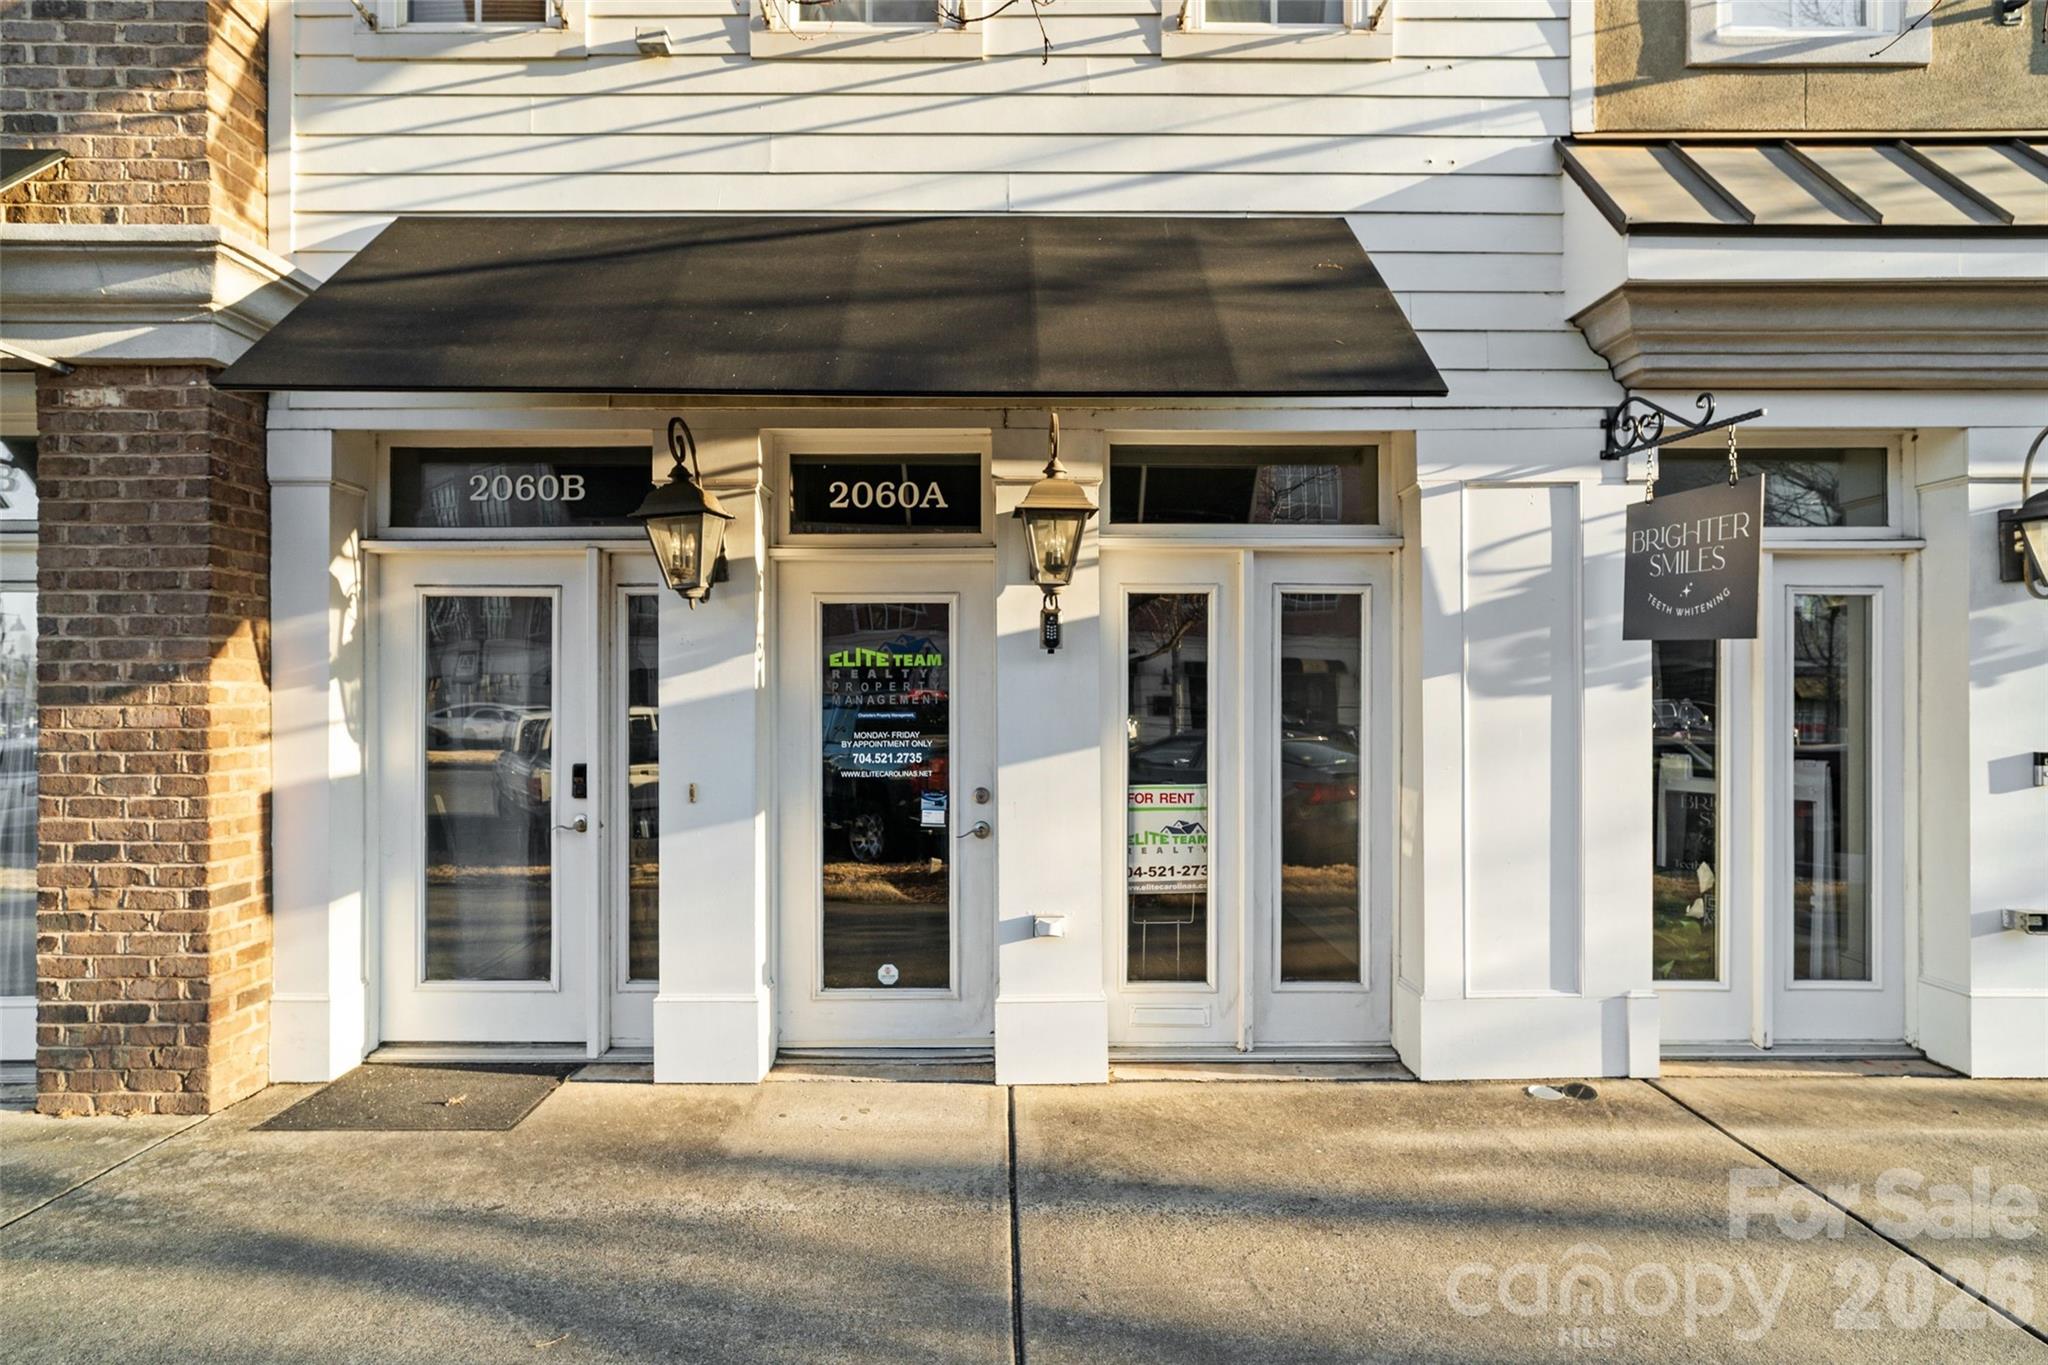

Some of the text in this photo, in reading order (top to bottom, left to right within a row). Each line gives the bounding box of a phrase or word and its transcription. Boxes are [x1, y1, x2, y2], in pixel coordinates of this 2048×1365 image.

[469, 475, 586, 502] 2060B
[828, 482, 948, 509] 2060A
[1632, 512, 1750, 554] BRIGHTER
[1649, 545, 1726, 577] SMILES
[1647, 587, 1731, 616] TEETH WHITENING
[829, 647, 942, 667] ELITE TEAM
[832, 669, 927, 679] REALTY
[832, 682, 940, 692] PROPERTY
[831, 695, 940, 706] MANAGEMENT
[891, 731, 920, 739] FRIDAY
[852, 740, 909, 748] APPOINTMENT
[911, 740, 933, 748] ONLY
[852, 753, 922, 764] 704.521.2735
[840, 770, 932, 778] WWW.ELITECAROLINAS.NET
[1128, 793, 1195, 804] FOR RENT
[1128, 831, 1207, 845] ELITE TEAM
